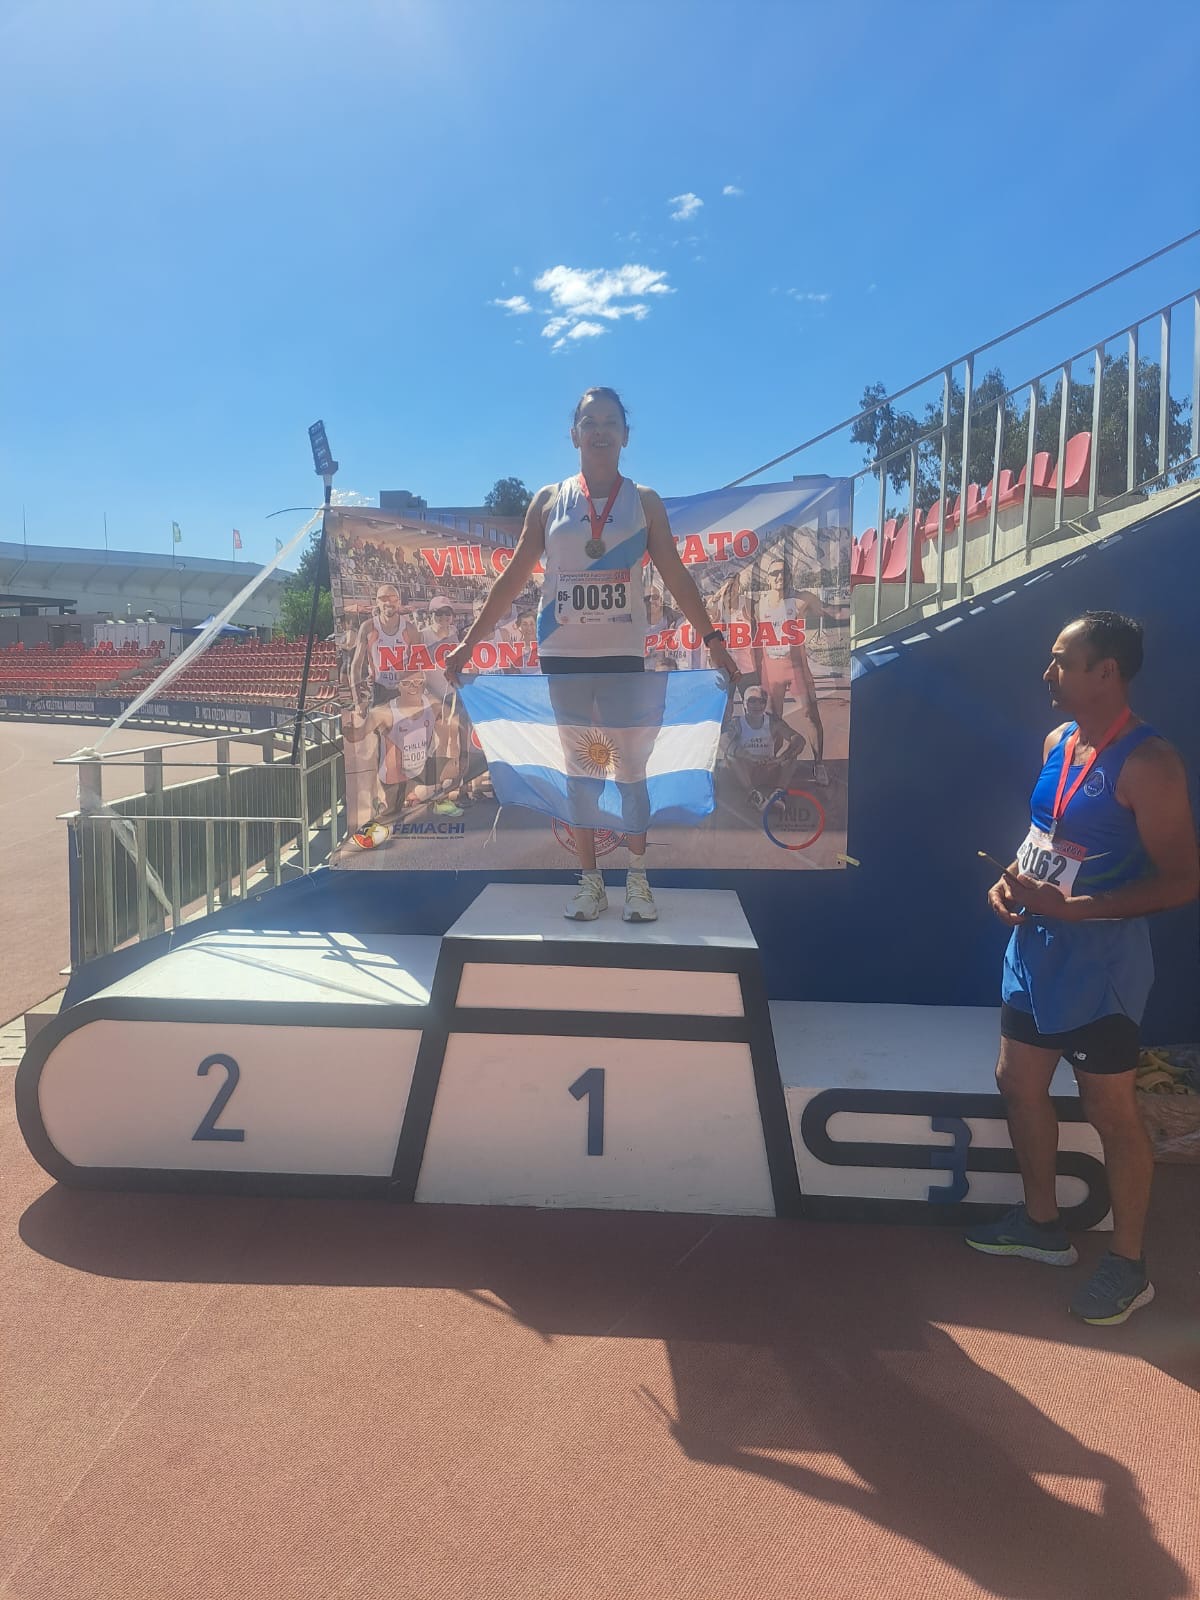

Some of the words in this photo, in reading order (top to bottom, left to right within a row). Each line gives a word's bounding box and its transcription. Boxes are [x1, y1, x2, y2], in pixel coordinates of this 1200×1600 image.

[420, 544, 487, 577] VIII
[558, 603, 564, 614] F
[572, 583, 627, 611] 0033
[378, 641, 539, 672] NACON
[392, 822, 465, 834] FEMACHI
[1021, 841, 1067, 886] 0162
[191, 1053, 245, 1142] 2
[568, 1067, 605, 1156] 1
[927, 1115, 973, 1204] 3
